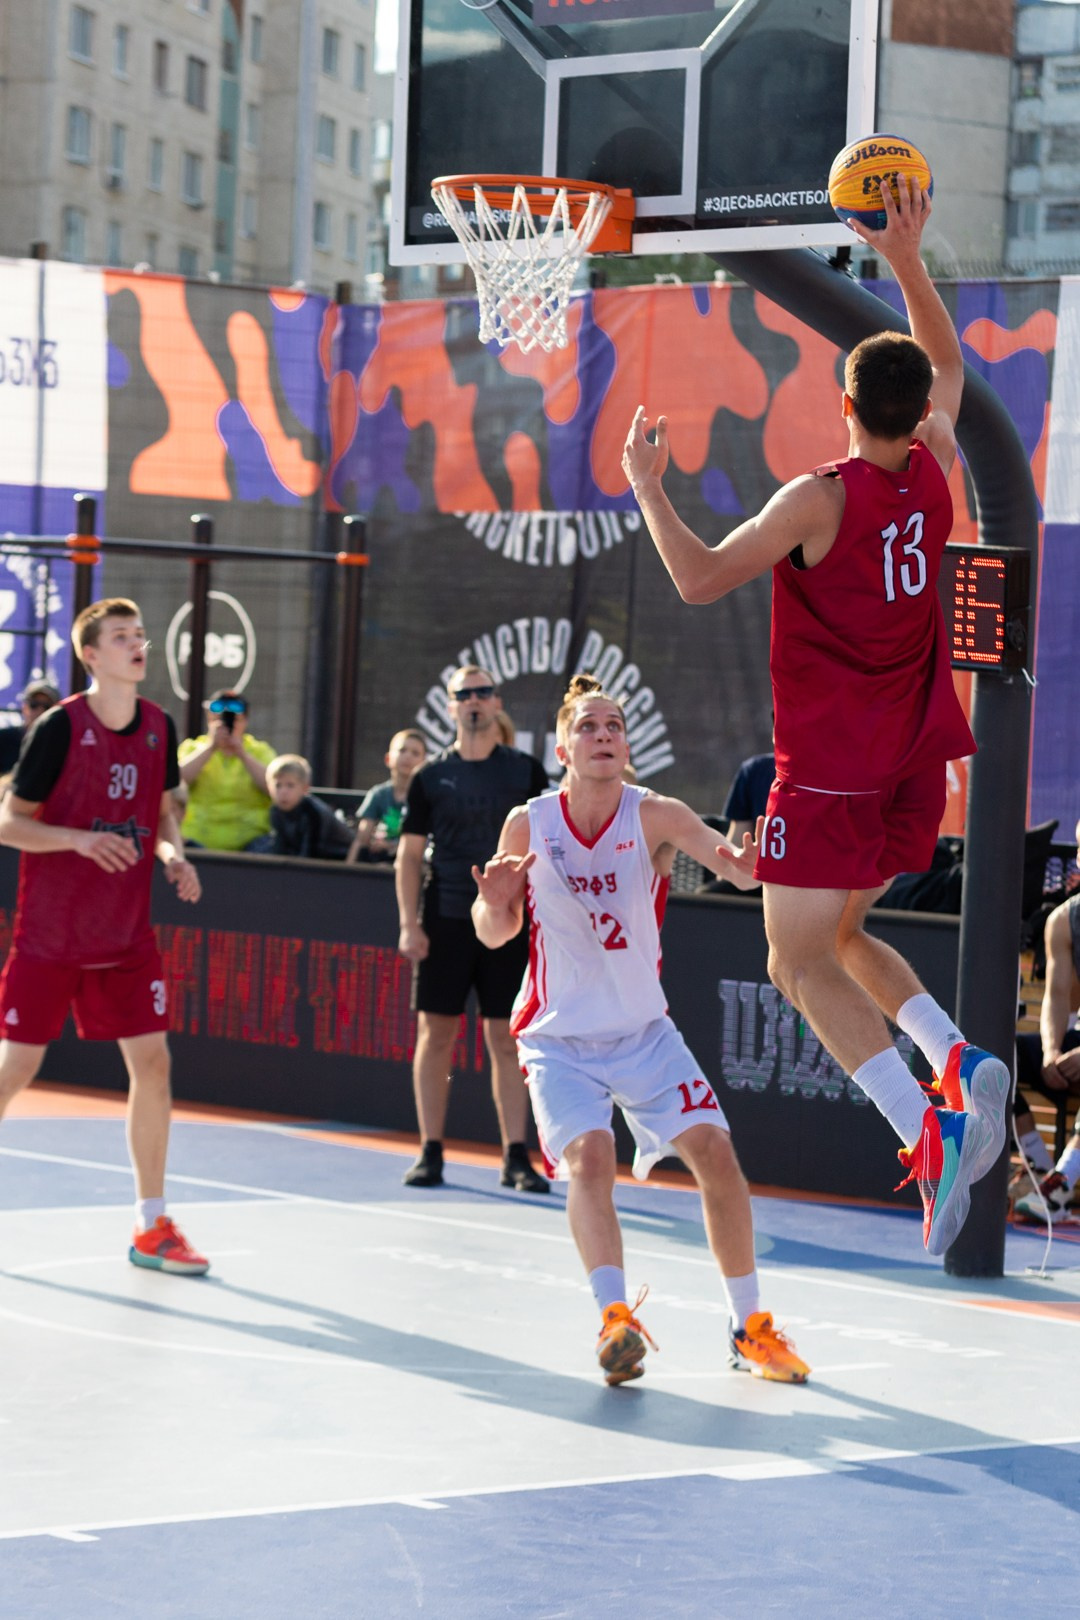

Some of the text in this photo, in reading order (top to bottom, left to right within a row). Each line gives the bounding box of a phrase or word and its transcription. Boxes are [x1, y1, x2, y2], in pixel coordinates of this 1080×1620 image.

[843, 143, 912, 169] Wilson
[881, 511, 927, 602] 13
[107, 763, 138, 800] 39
[761, 815, 786, 860] 13
[589, 912, 628, 951] 12
[677, 1079, 718, 1114] 12
